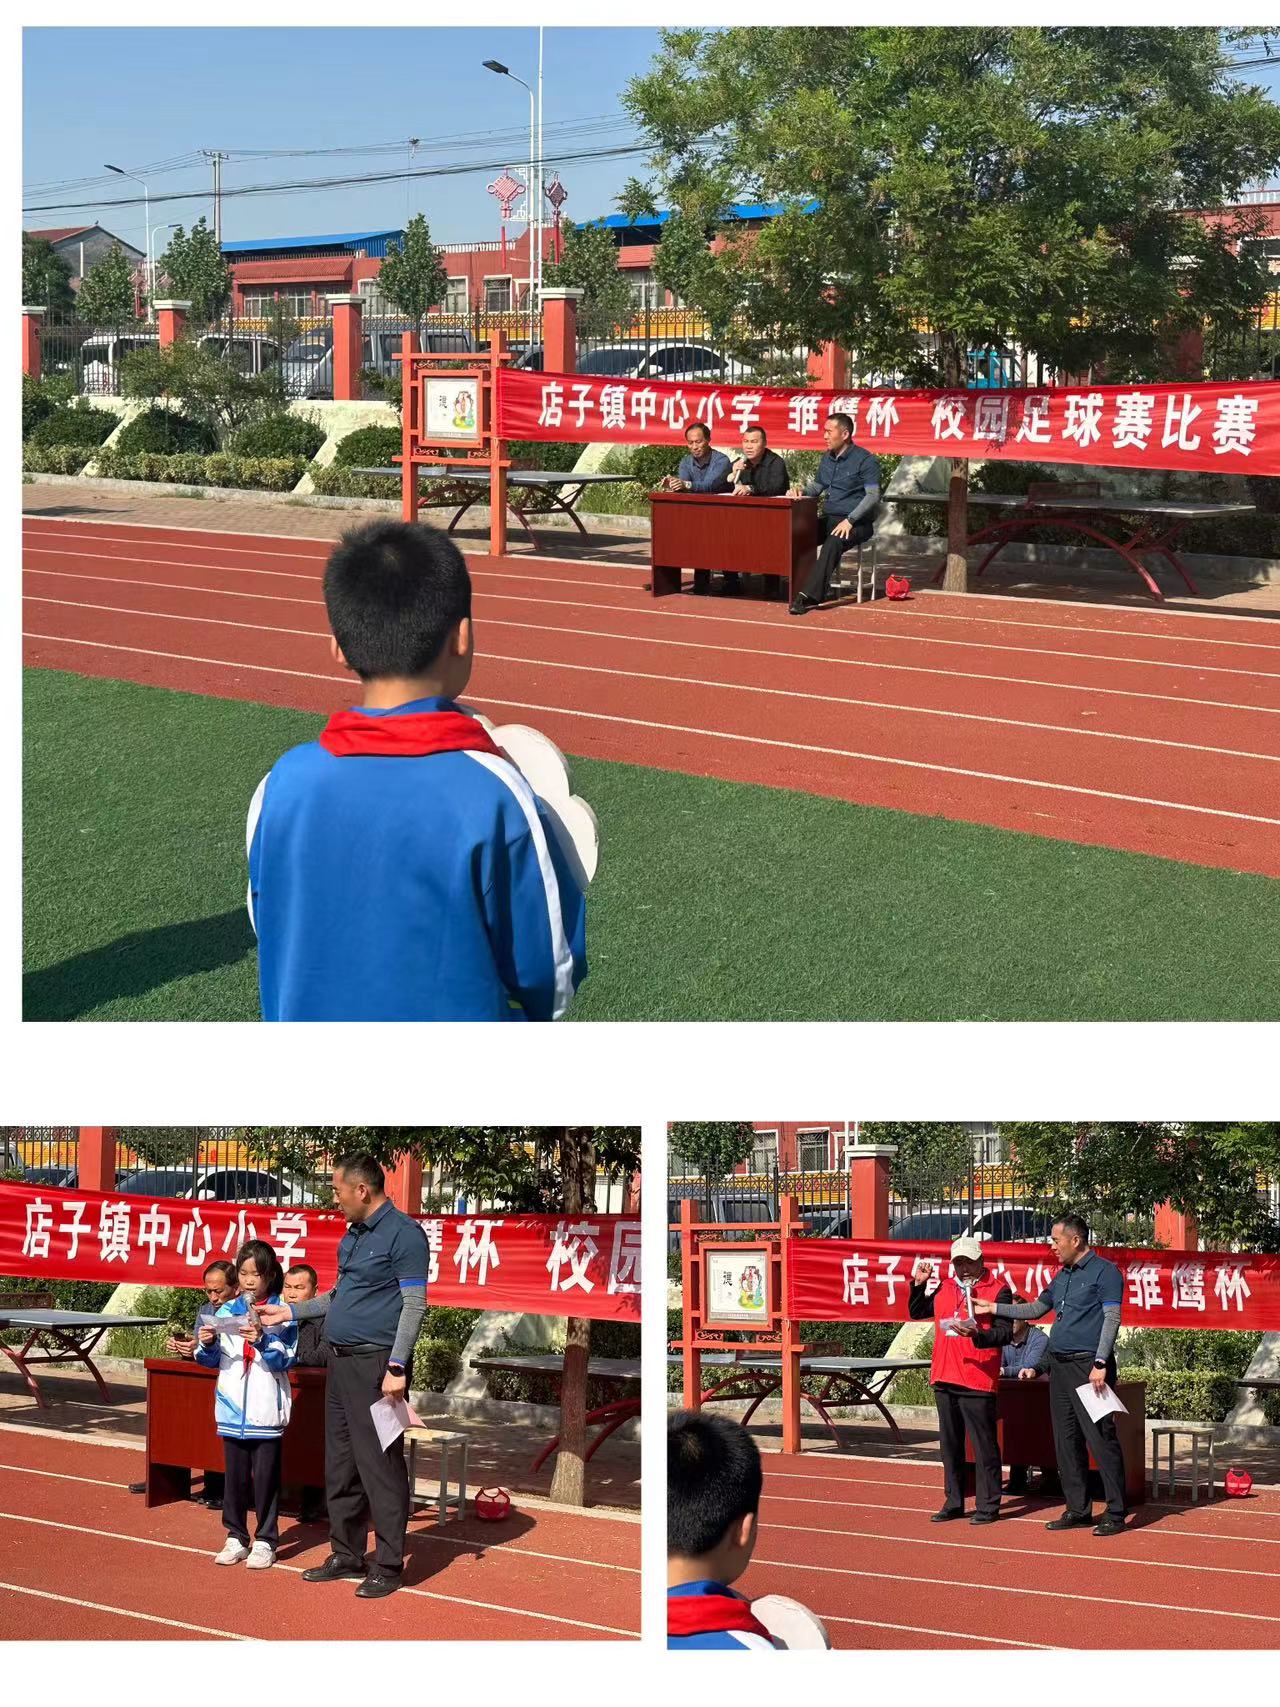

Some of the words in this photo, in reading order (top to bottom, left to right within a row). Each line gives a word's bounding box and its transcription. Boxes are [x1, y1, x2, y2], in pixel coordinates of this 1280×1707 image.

[538, 381, 763, 434] 店子镇中心小学
[930, 393, 1259, 457] 校园足球赛比赛
[21, 1195, 308, 1281] 店子镇中心小学
[546, 1219, 641, 1296] 校园
